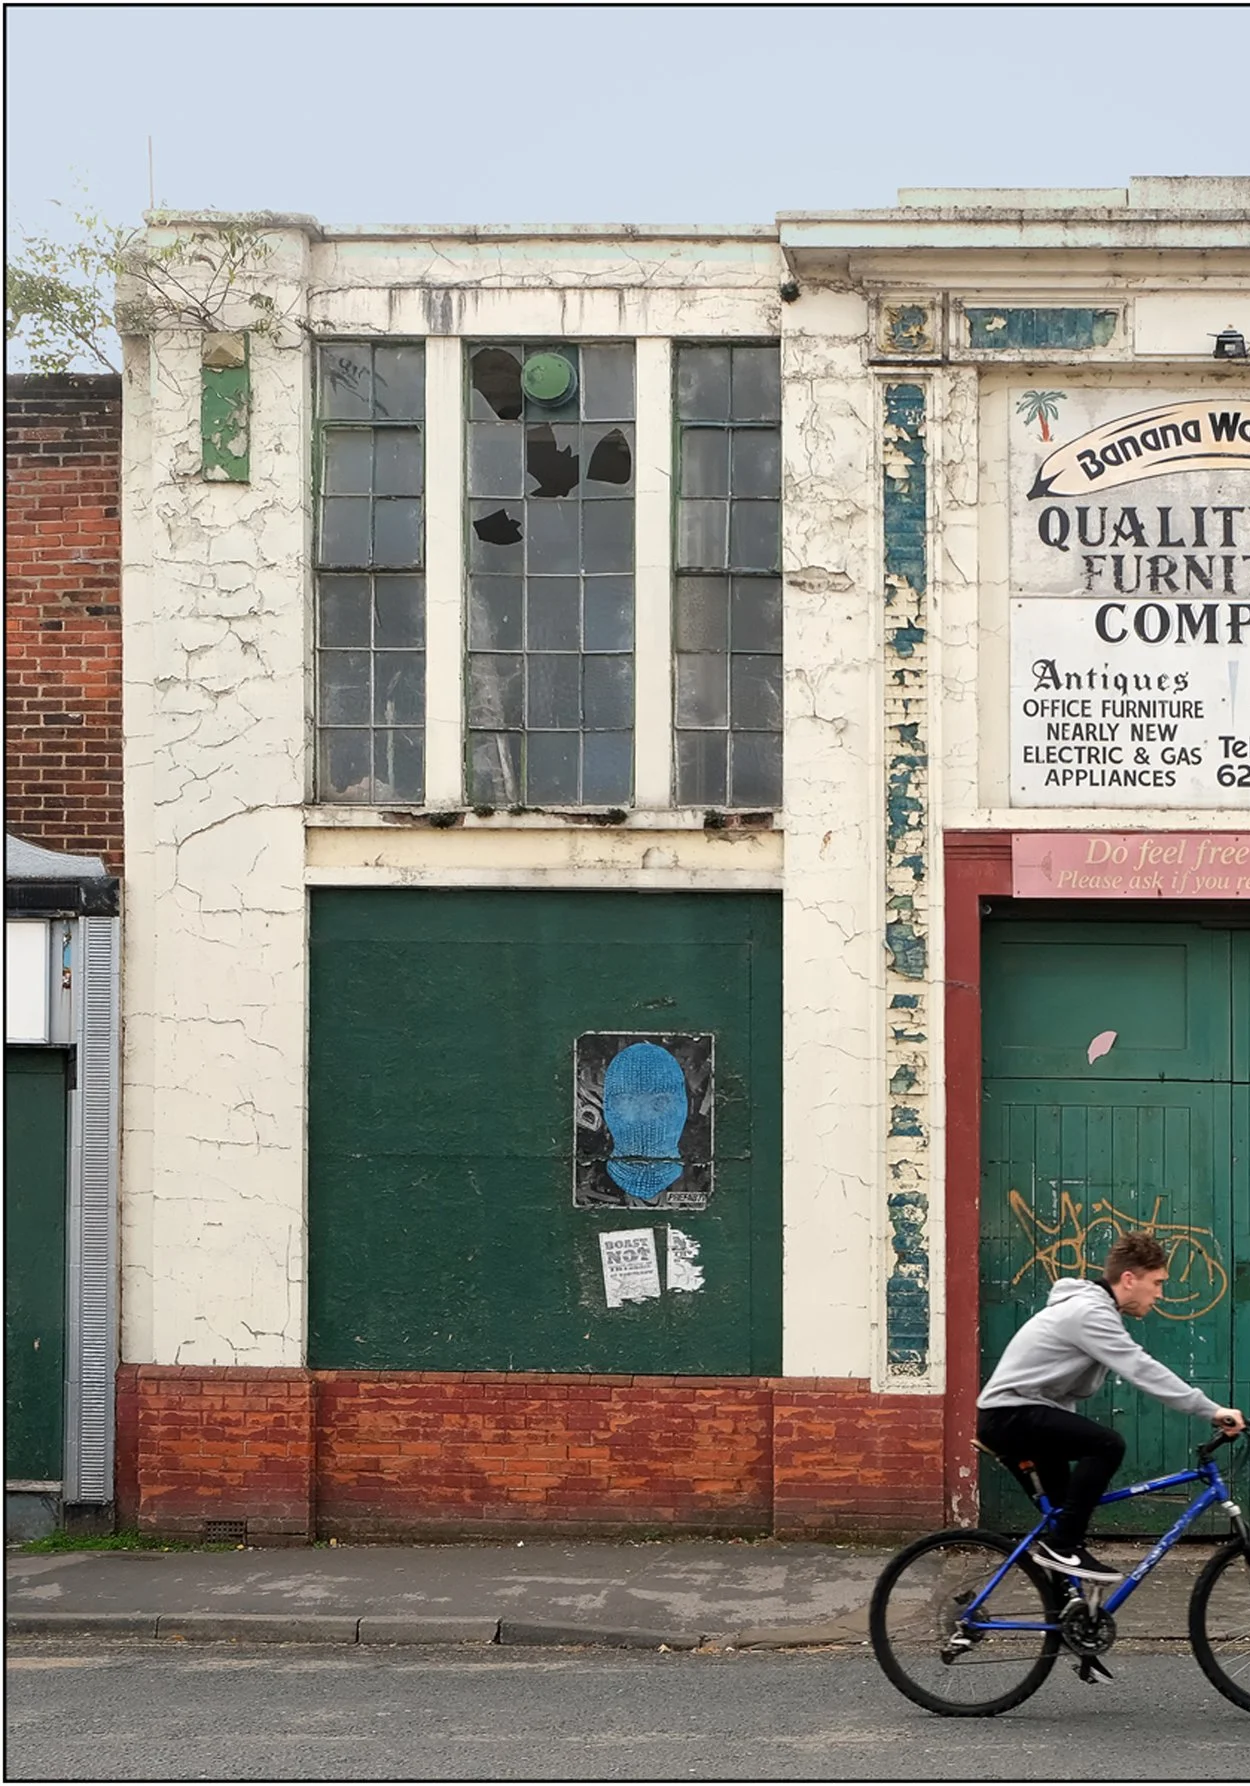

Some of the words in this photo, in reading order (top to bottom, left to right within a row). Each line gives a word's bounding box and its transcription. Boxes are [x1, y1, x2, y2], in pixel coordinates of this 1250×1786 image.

[1077, 419, 1202, 482] Banana
[1032, 659, 1189, 696] Antiques
[1023, 698, 1092, 718] OFFICE
[1101, 699, 1204, 719] FURNITURE
[1047, 722, 1120, 742] NEARLY
[1131, 723, 1178, 742] NEW
[1023, 745, 1123, 765] ELECTRIC
[1133, 746, 1150, 765] &
[1160, 746, 1203, 766] GAS
[1044, 768, 1176, 787] APPLIANCES
[1085, 840, 1128, 864] Do
[1134, 838, 1185, 870] feel
[1194, 838, 1249, 870] free
[1057, 872, 1121, 889] Please
[1130, 873, 1164, 890] ask
[1171, 871, 1192, 894] if
[1195, 876, 1232, 894] you
[606, 1247, 650, 1264] NOT
